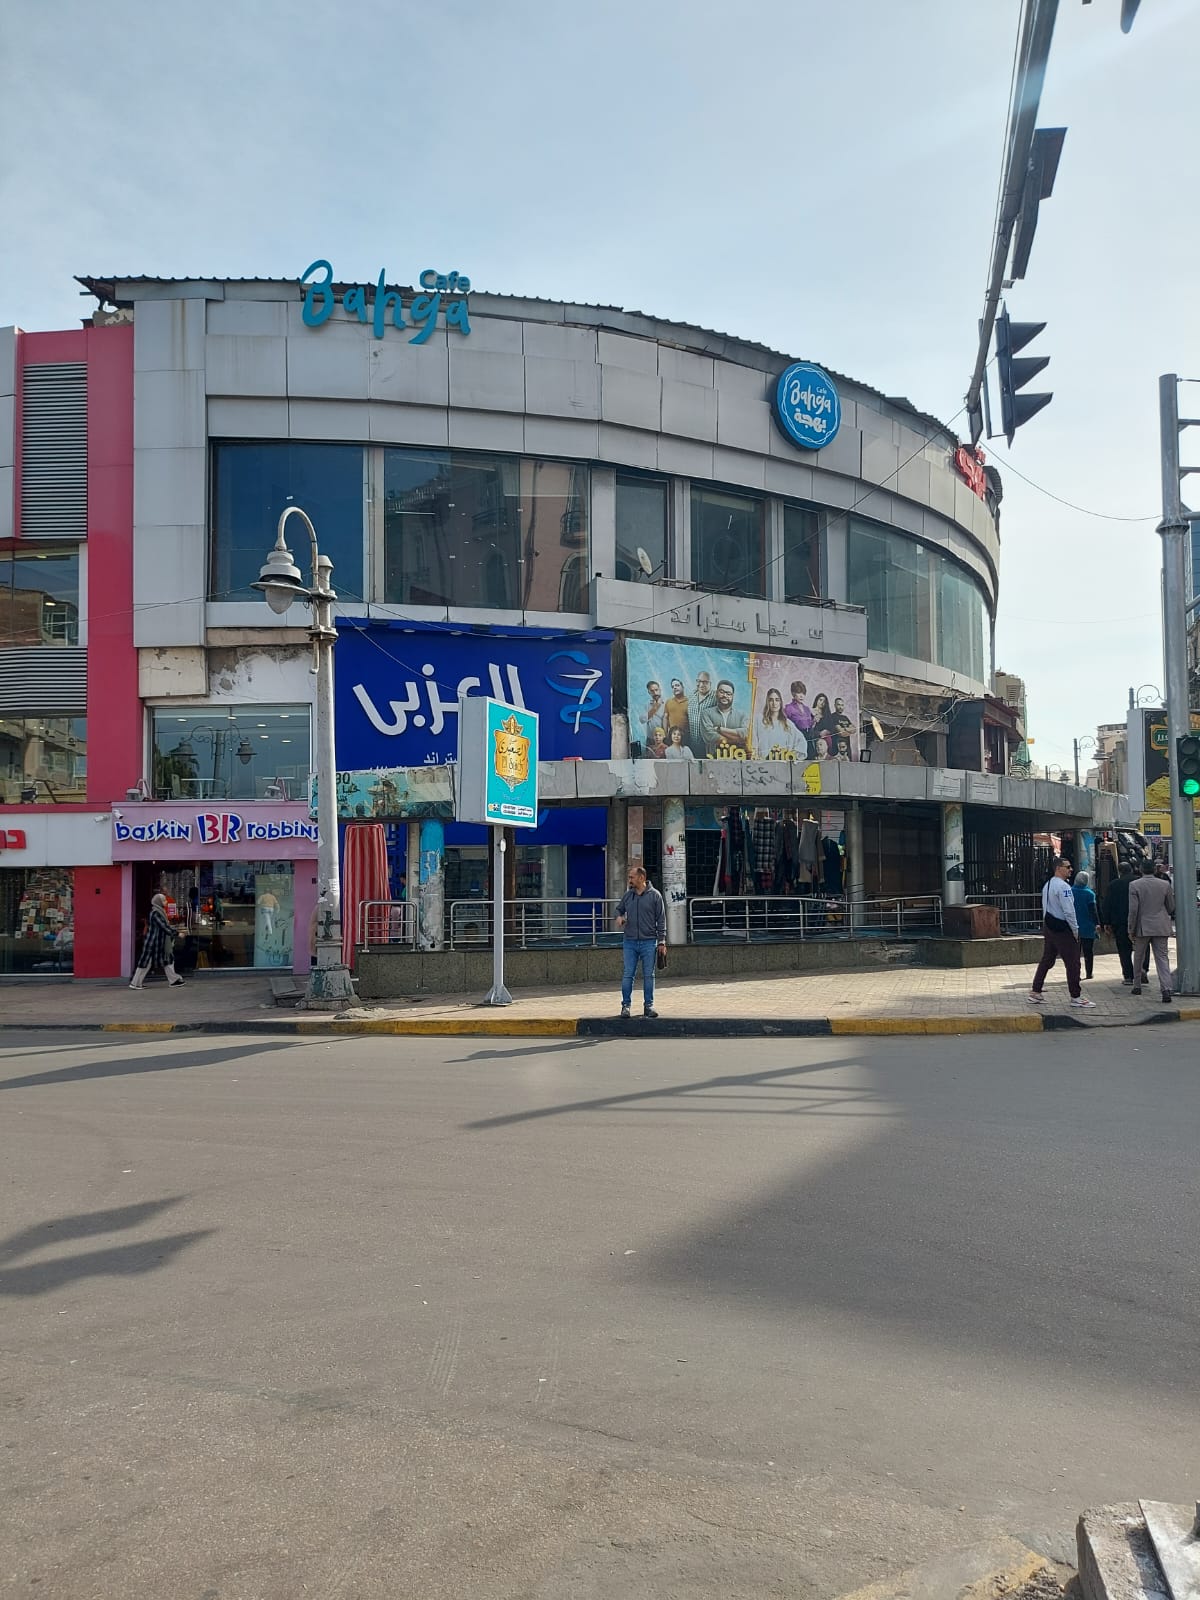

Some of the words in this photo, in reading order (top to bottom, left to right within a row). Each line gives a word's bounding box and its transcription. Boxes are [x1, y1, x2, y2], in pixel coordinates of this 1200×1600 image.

[419, 269, 471, 292] Cafe
[300, 259, 471, 344] Bahga
[790, 379, 832, 415] Bahga
